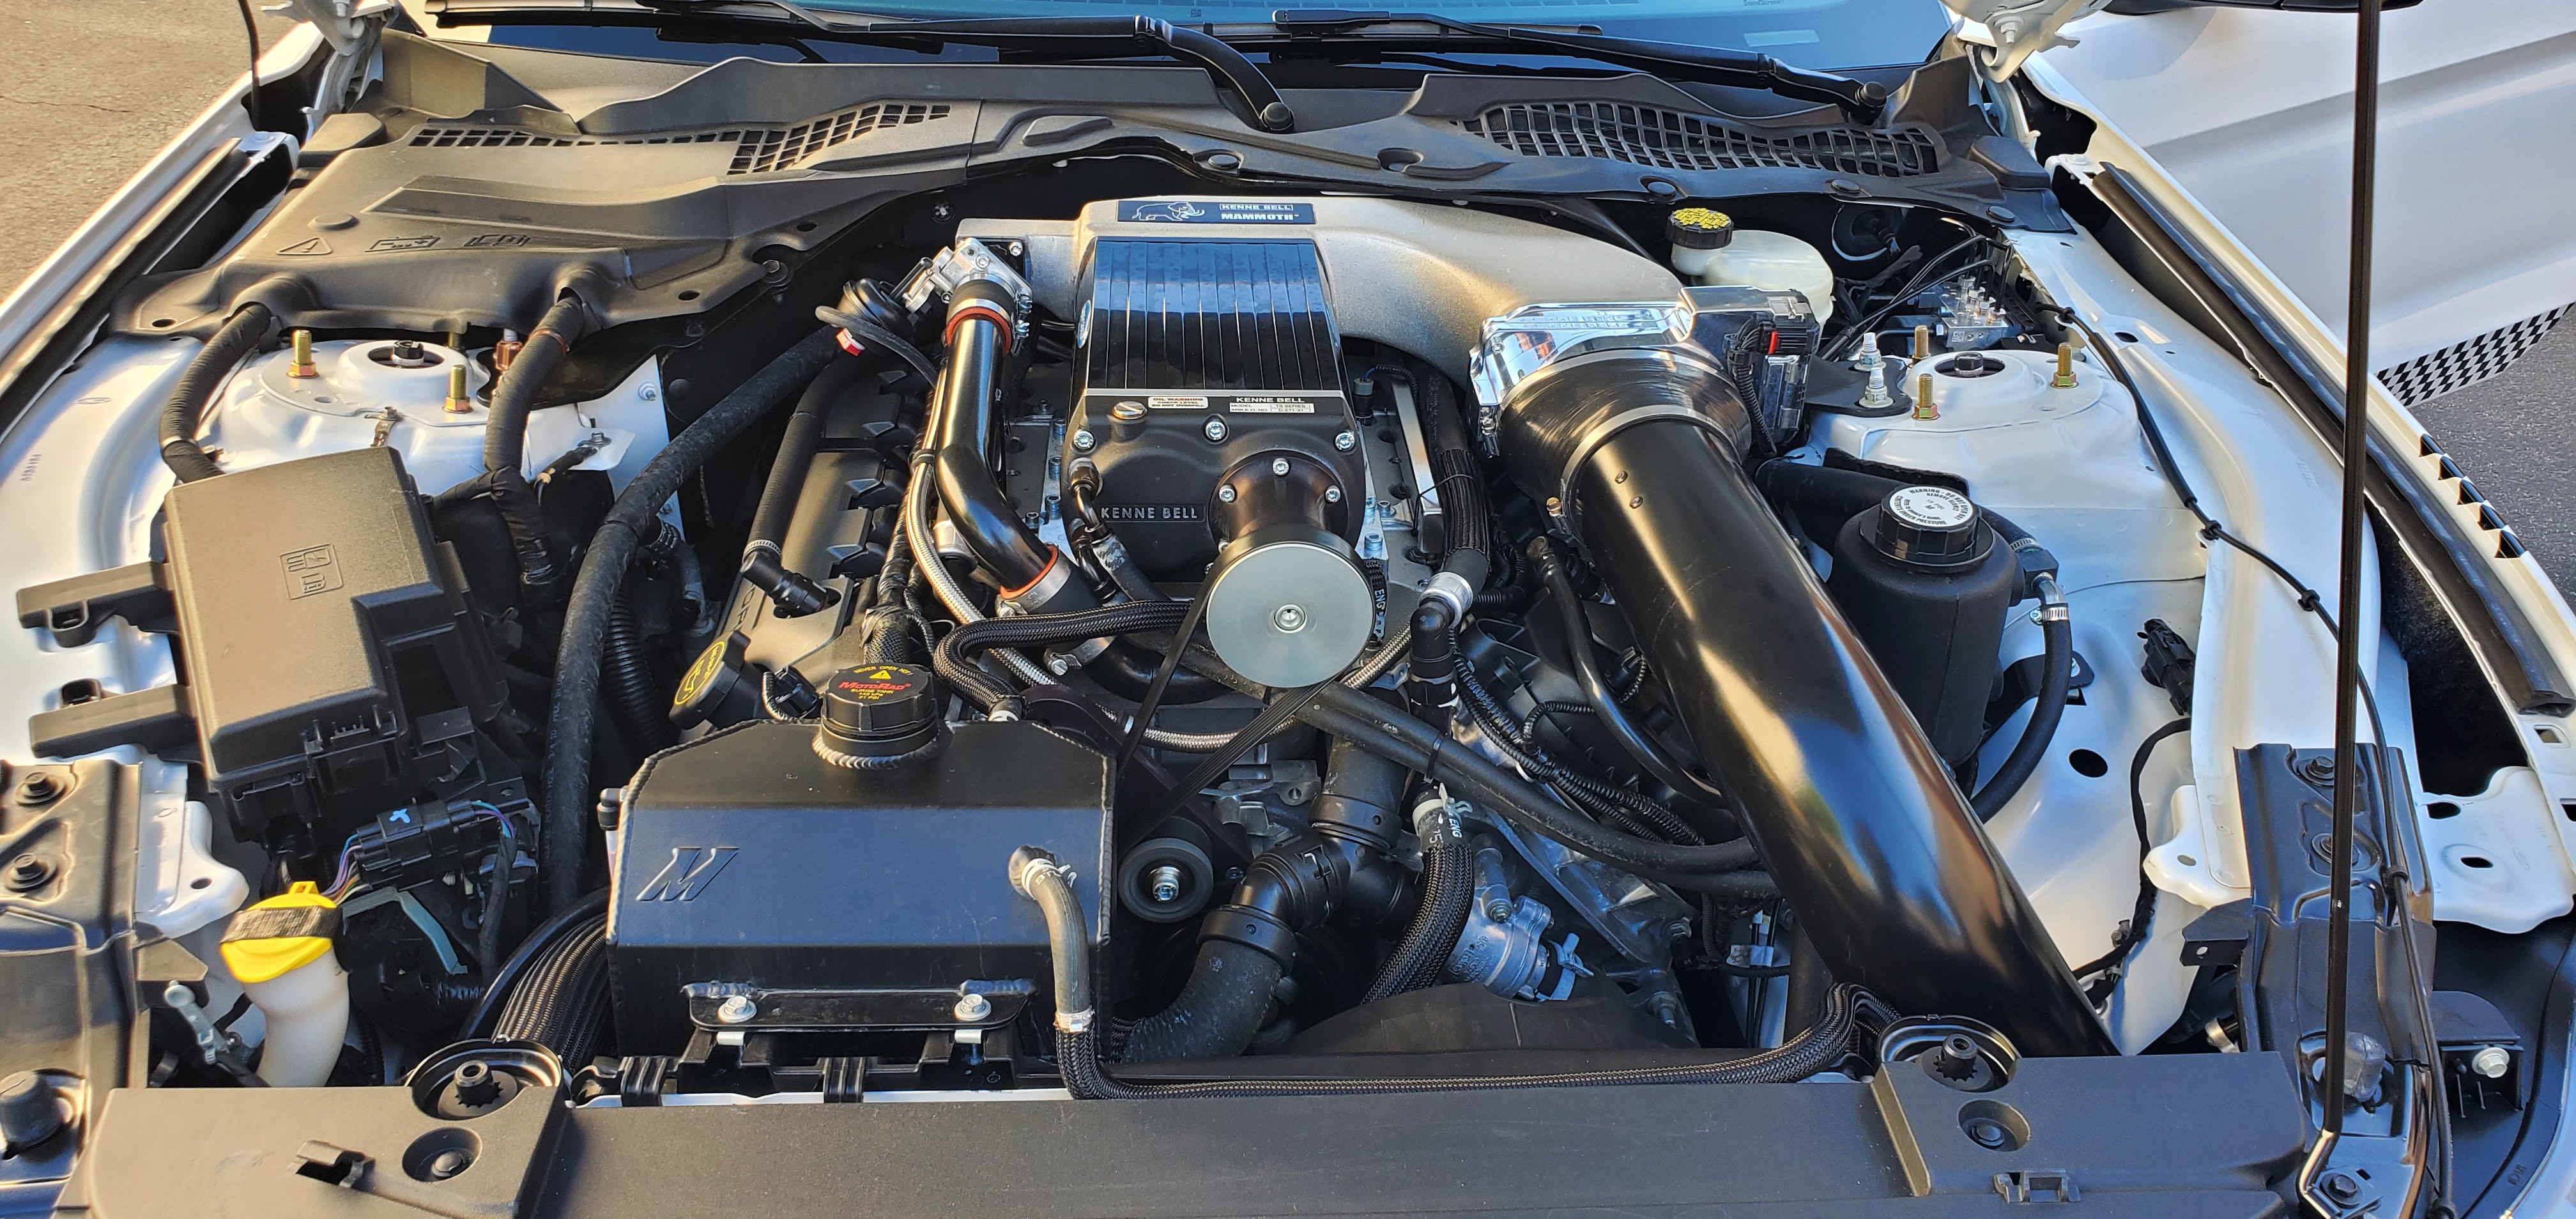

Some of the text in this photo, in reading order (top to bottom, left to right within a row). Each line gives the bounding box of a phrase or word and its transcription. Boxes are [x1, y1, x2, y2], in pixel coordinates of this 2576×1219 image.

[1101, 507, 1197, 519] KENNE BELL
[1374, 588, 1386, 611] ENG
[1448, 818, 1462, 838] ENG
